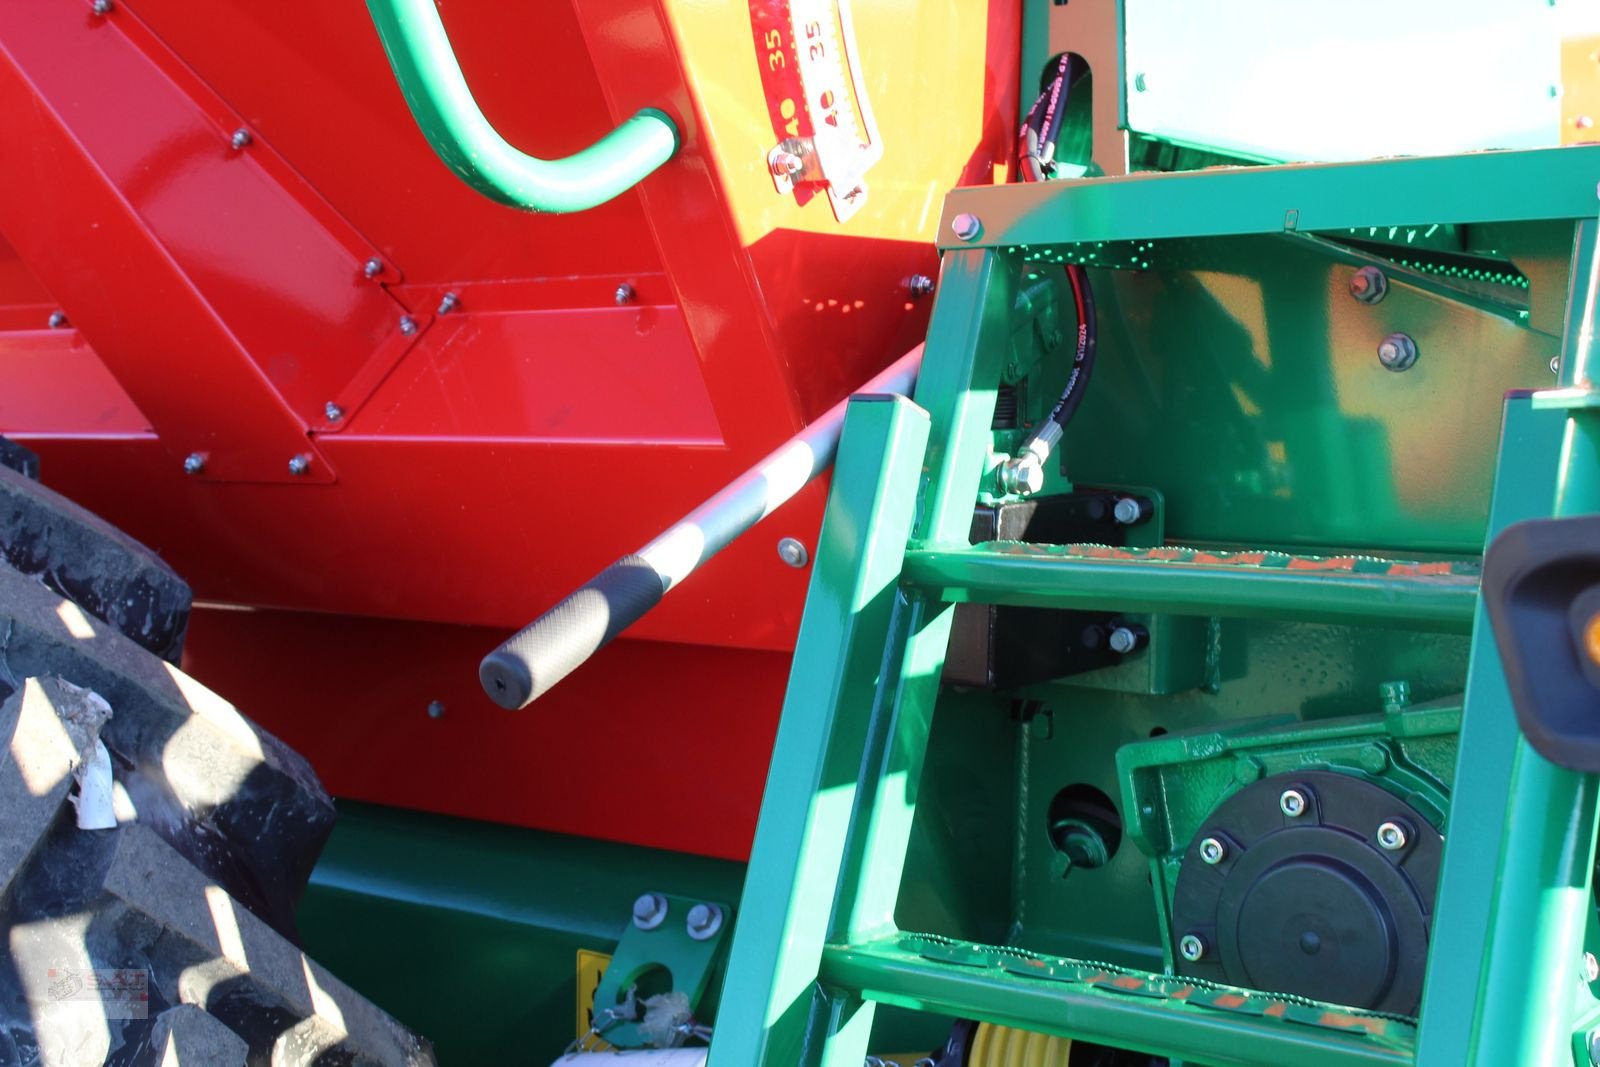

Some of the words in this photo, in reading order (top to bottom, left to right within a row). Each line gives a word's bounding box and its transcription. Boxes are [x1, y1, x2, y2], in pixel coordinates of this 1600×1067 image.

[764, 29, 785, 72] 35
[805, 21, 825, 61] 35
[780, 98, 799, 137] 40
[820, 90, 838, 127] 40
